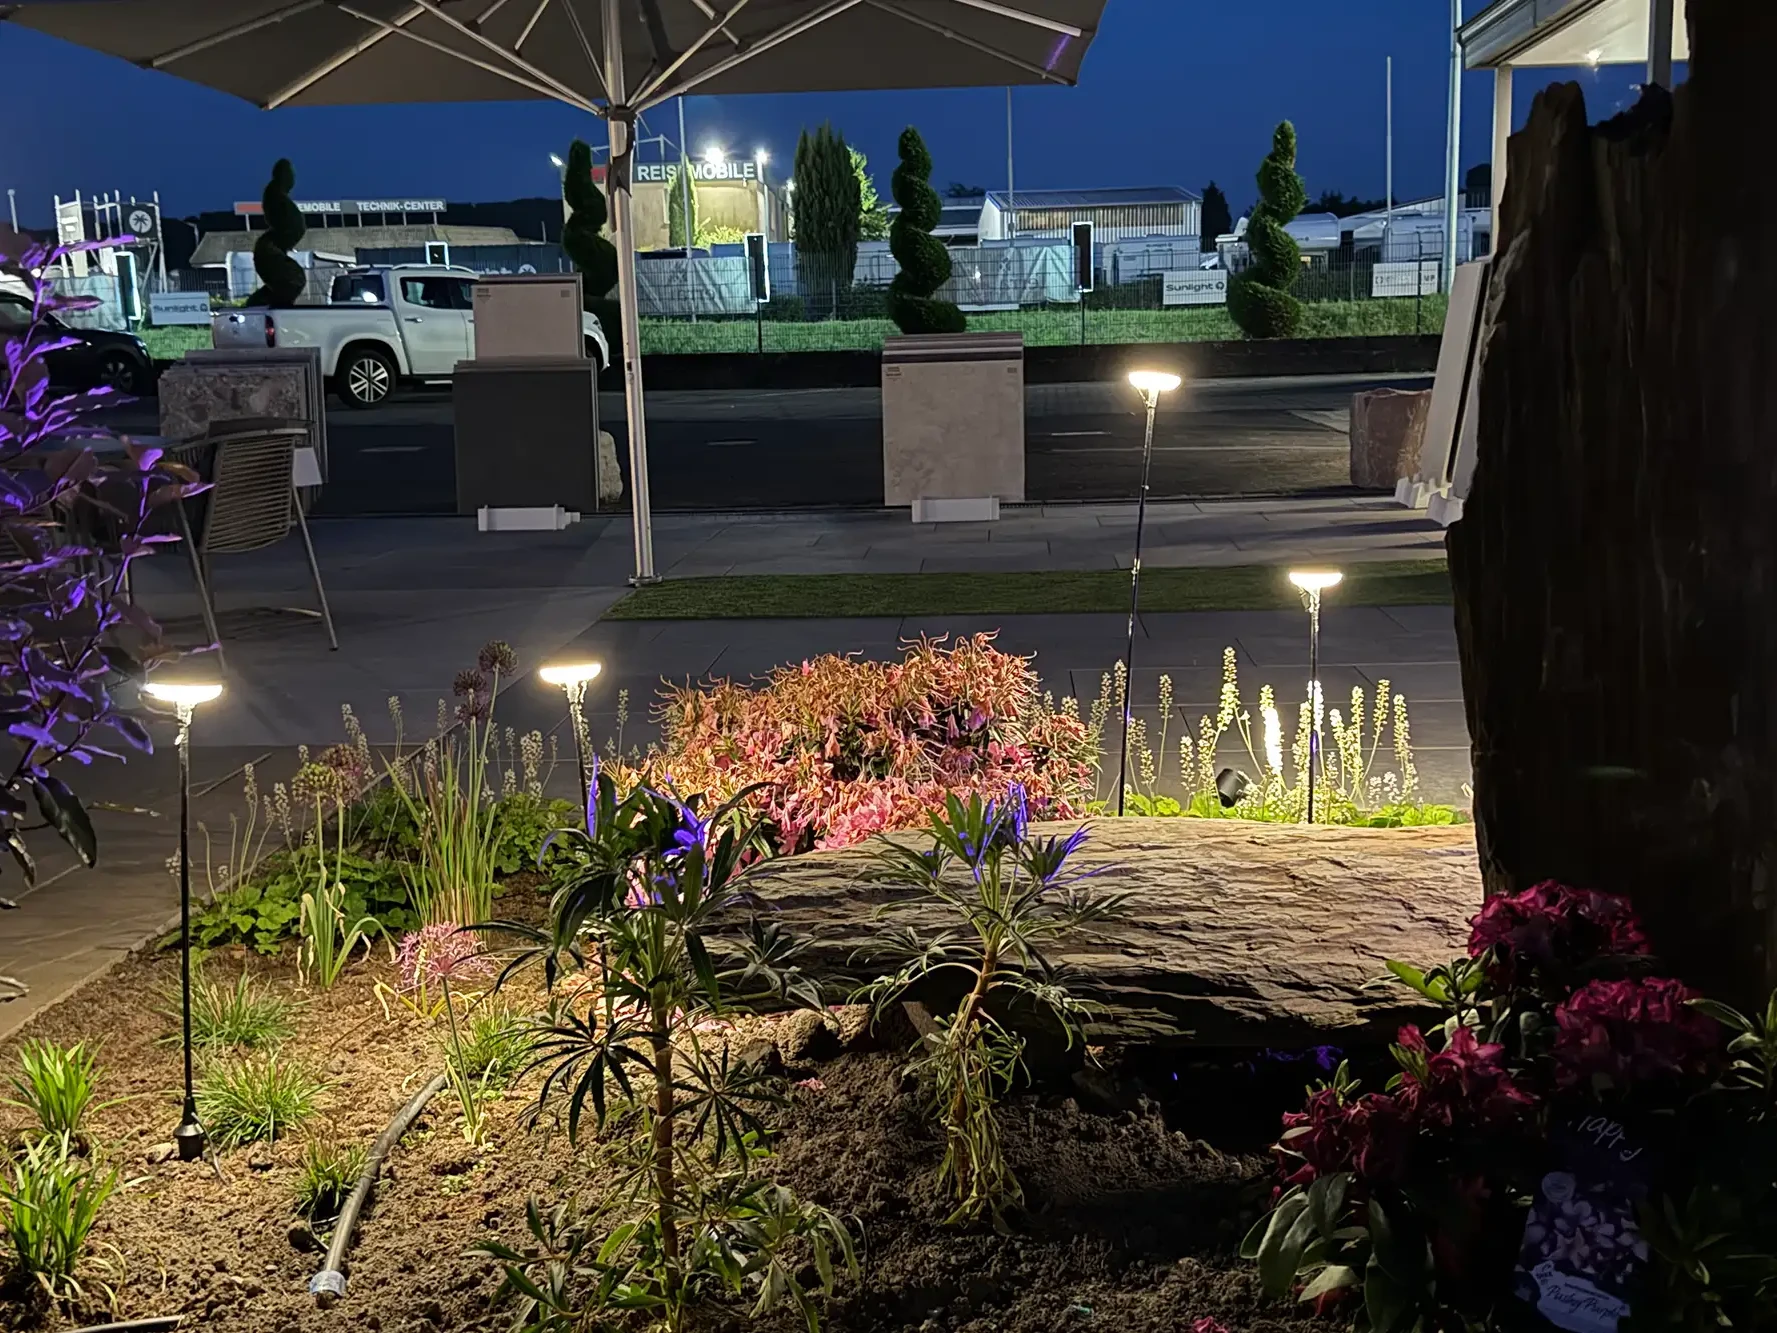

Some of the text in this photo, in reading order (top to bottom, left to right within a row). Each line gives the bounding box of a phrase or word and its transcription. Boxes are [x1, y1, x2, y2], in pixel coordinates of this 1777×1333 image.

[637, 163, 755, 181] REISMOBILE
[297, 201, 445, 212] EMOBILE TECHNIK-CENTER
[1165, 282, 1213, 293] Sunlight
